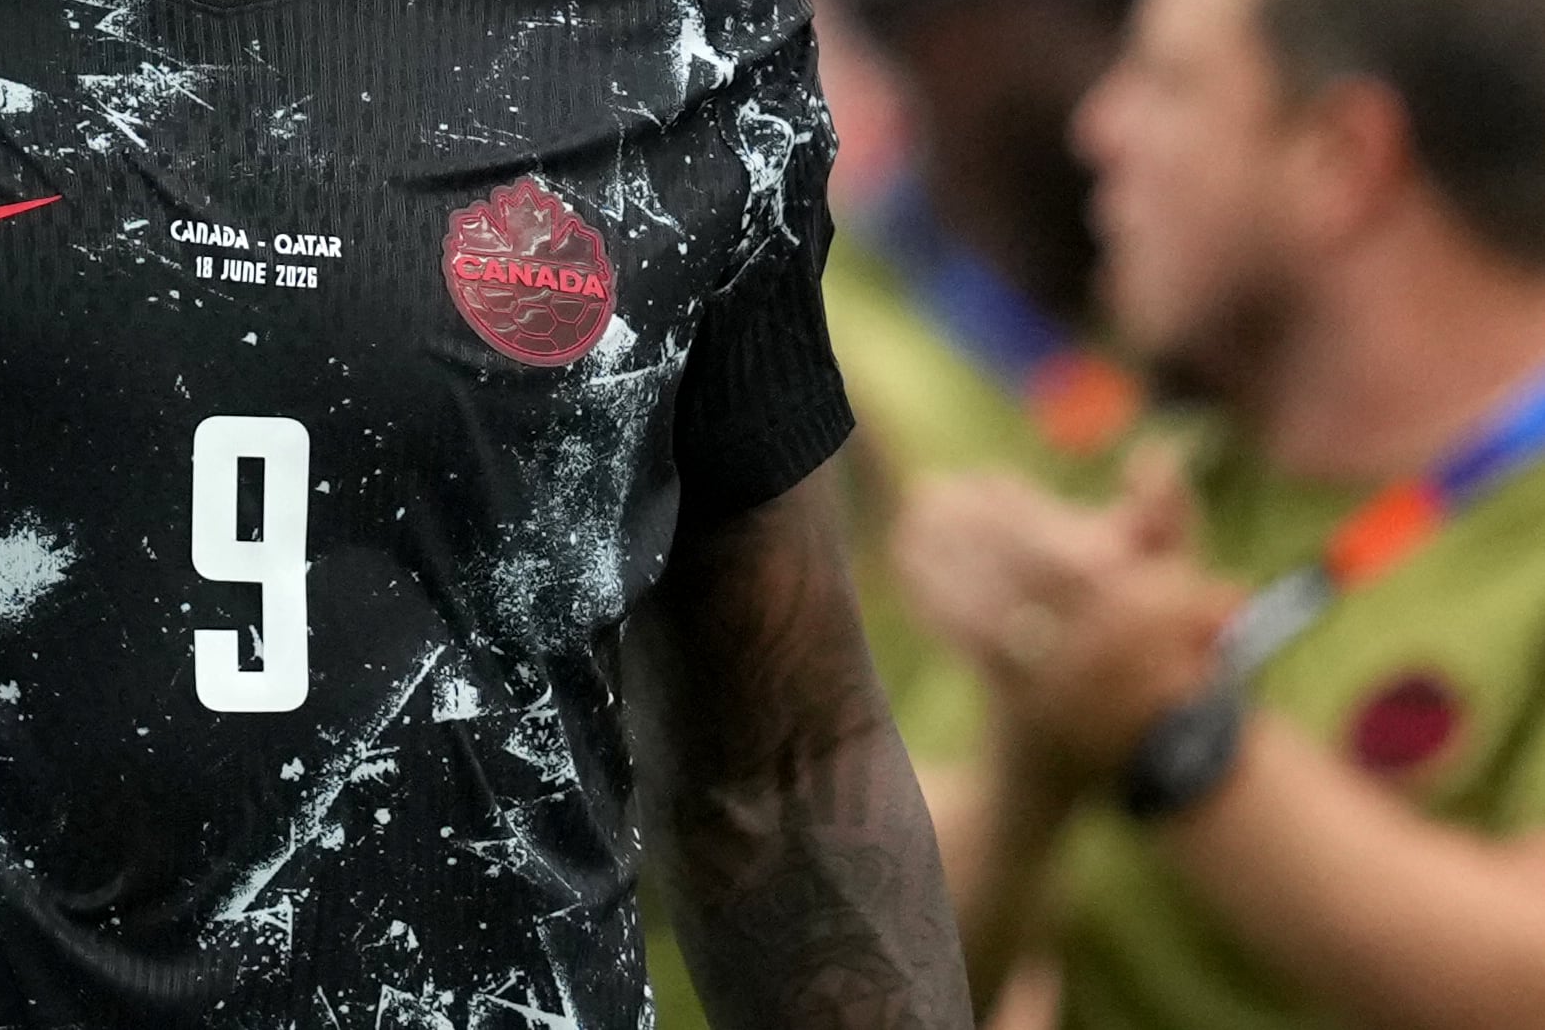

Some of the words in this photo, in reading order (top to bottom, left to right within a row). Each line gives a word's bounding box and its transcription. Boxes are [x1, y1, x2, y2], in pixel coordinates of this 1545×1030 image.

[169, 219, 250, 250] CANADA
[273, 233, 342, 258] QATAR
[195, 256, 213, 279] 18
[220, 258, 267, 284] JUNE
[274, 264, 318, 289] 2026
[453, 256, 605, 299] CANADA
[191, 415, 311, 713] 9
